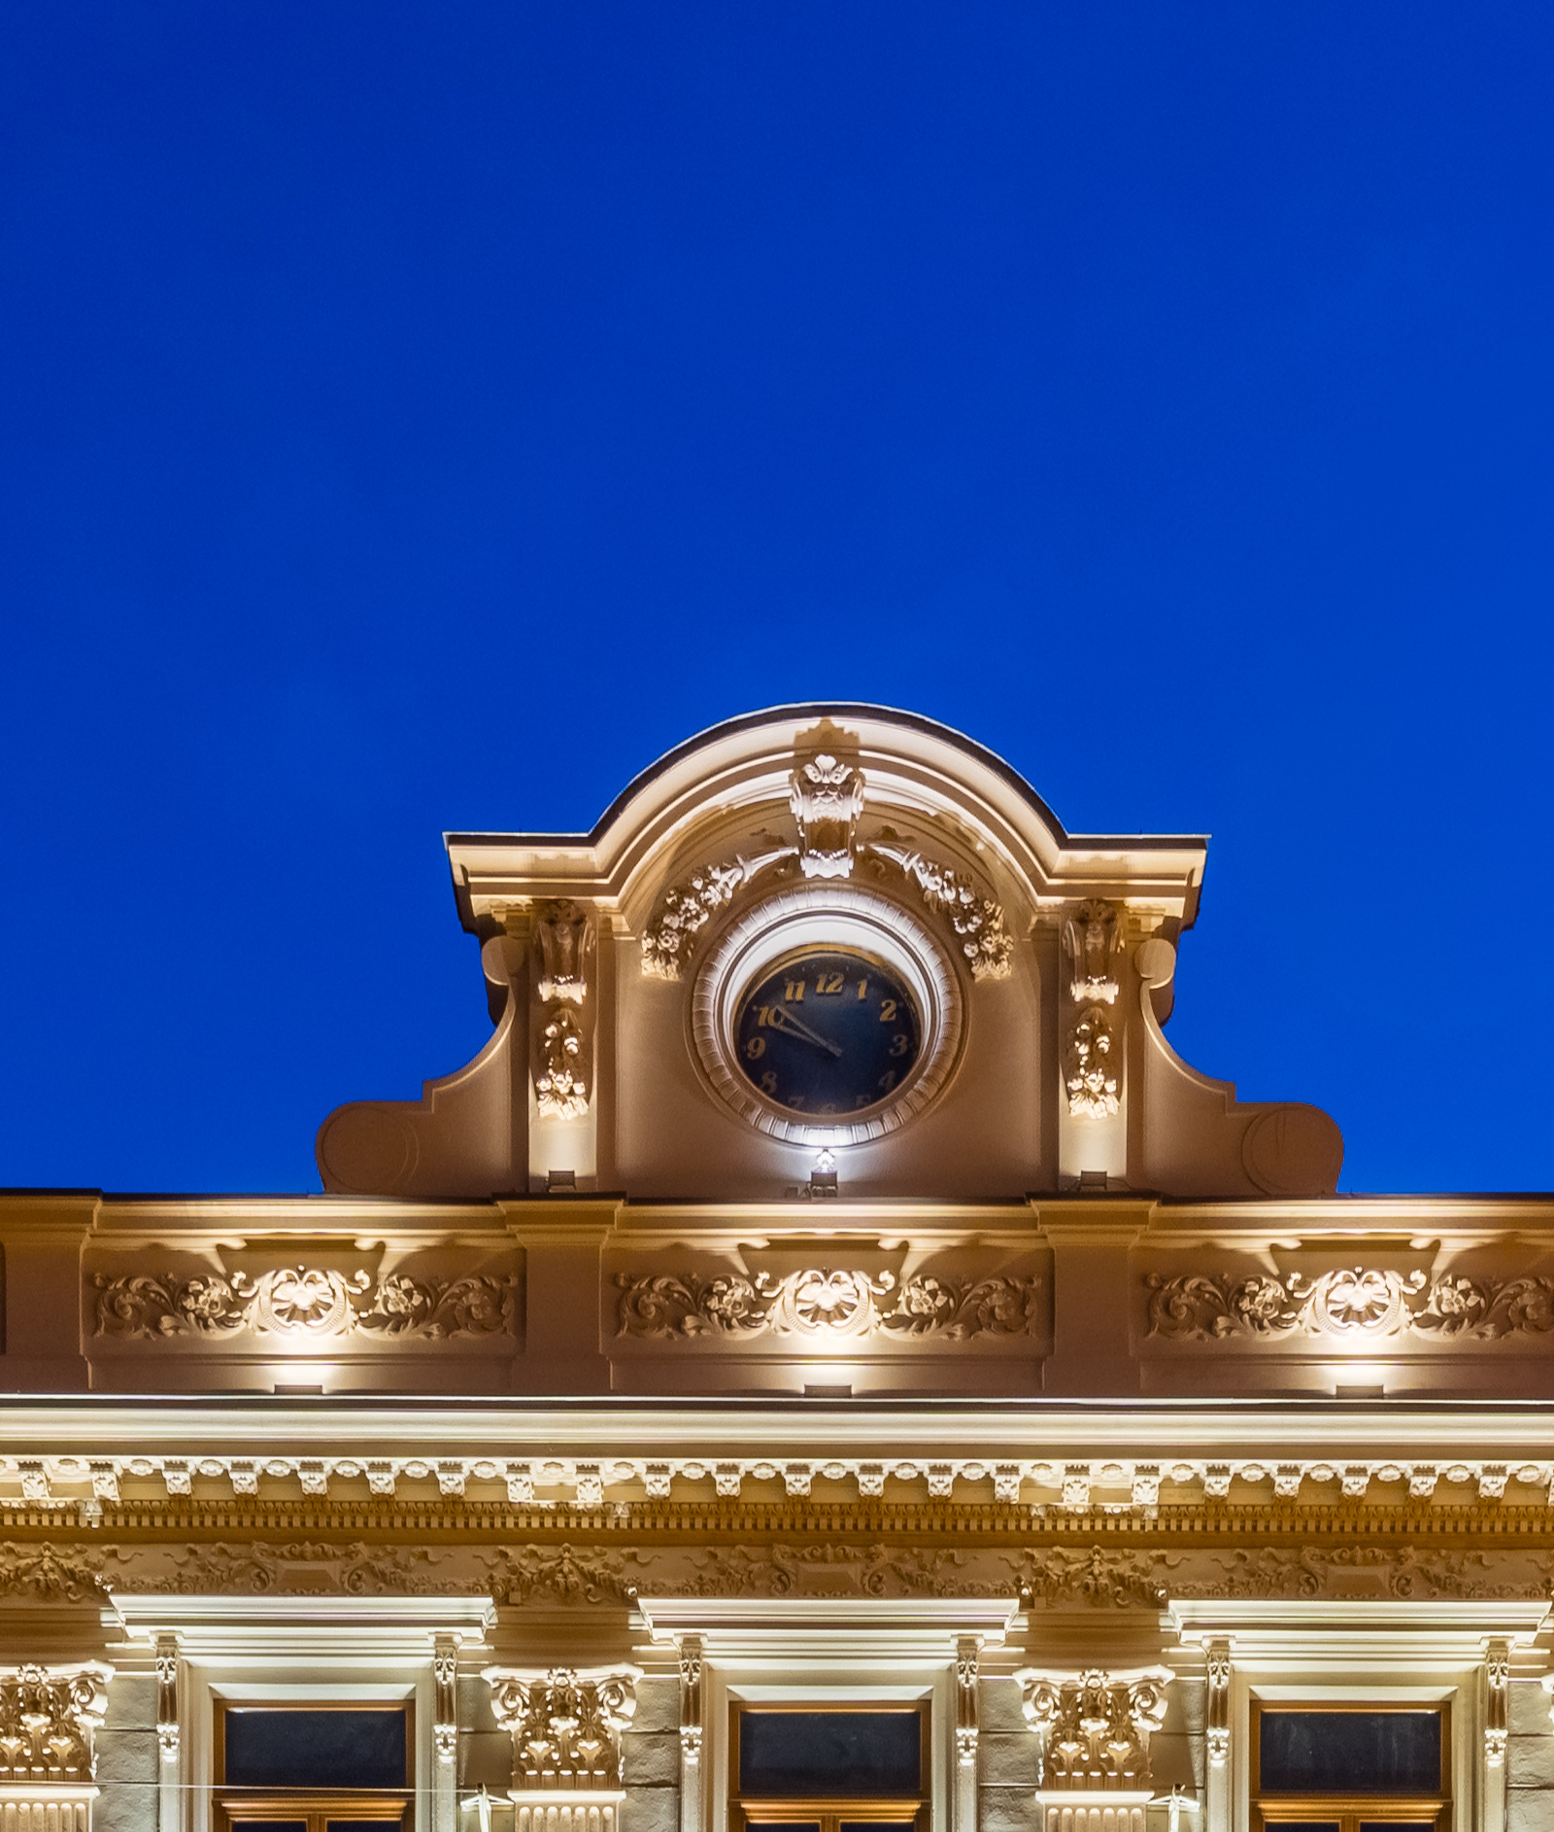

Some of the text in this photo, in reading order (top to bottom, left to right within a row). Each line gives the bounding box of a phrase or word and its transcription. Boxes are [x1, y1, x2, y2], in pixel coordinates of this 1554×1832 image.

[785, 981, 805, 1001] 11
[816, 973, 844, 994] 12
[857, 980, 868, 1000] 1
[758, 1006, 786, 1027] 10
[879, 999, 897, 1022] 2
[747, 1037, 766, 1060] 9
[889, 1034, 908, 1056] 3
[761, 1071, 777, 1094] 8
[879, 1070, 895, 1093] 4
